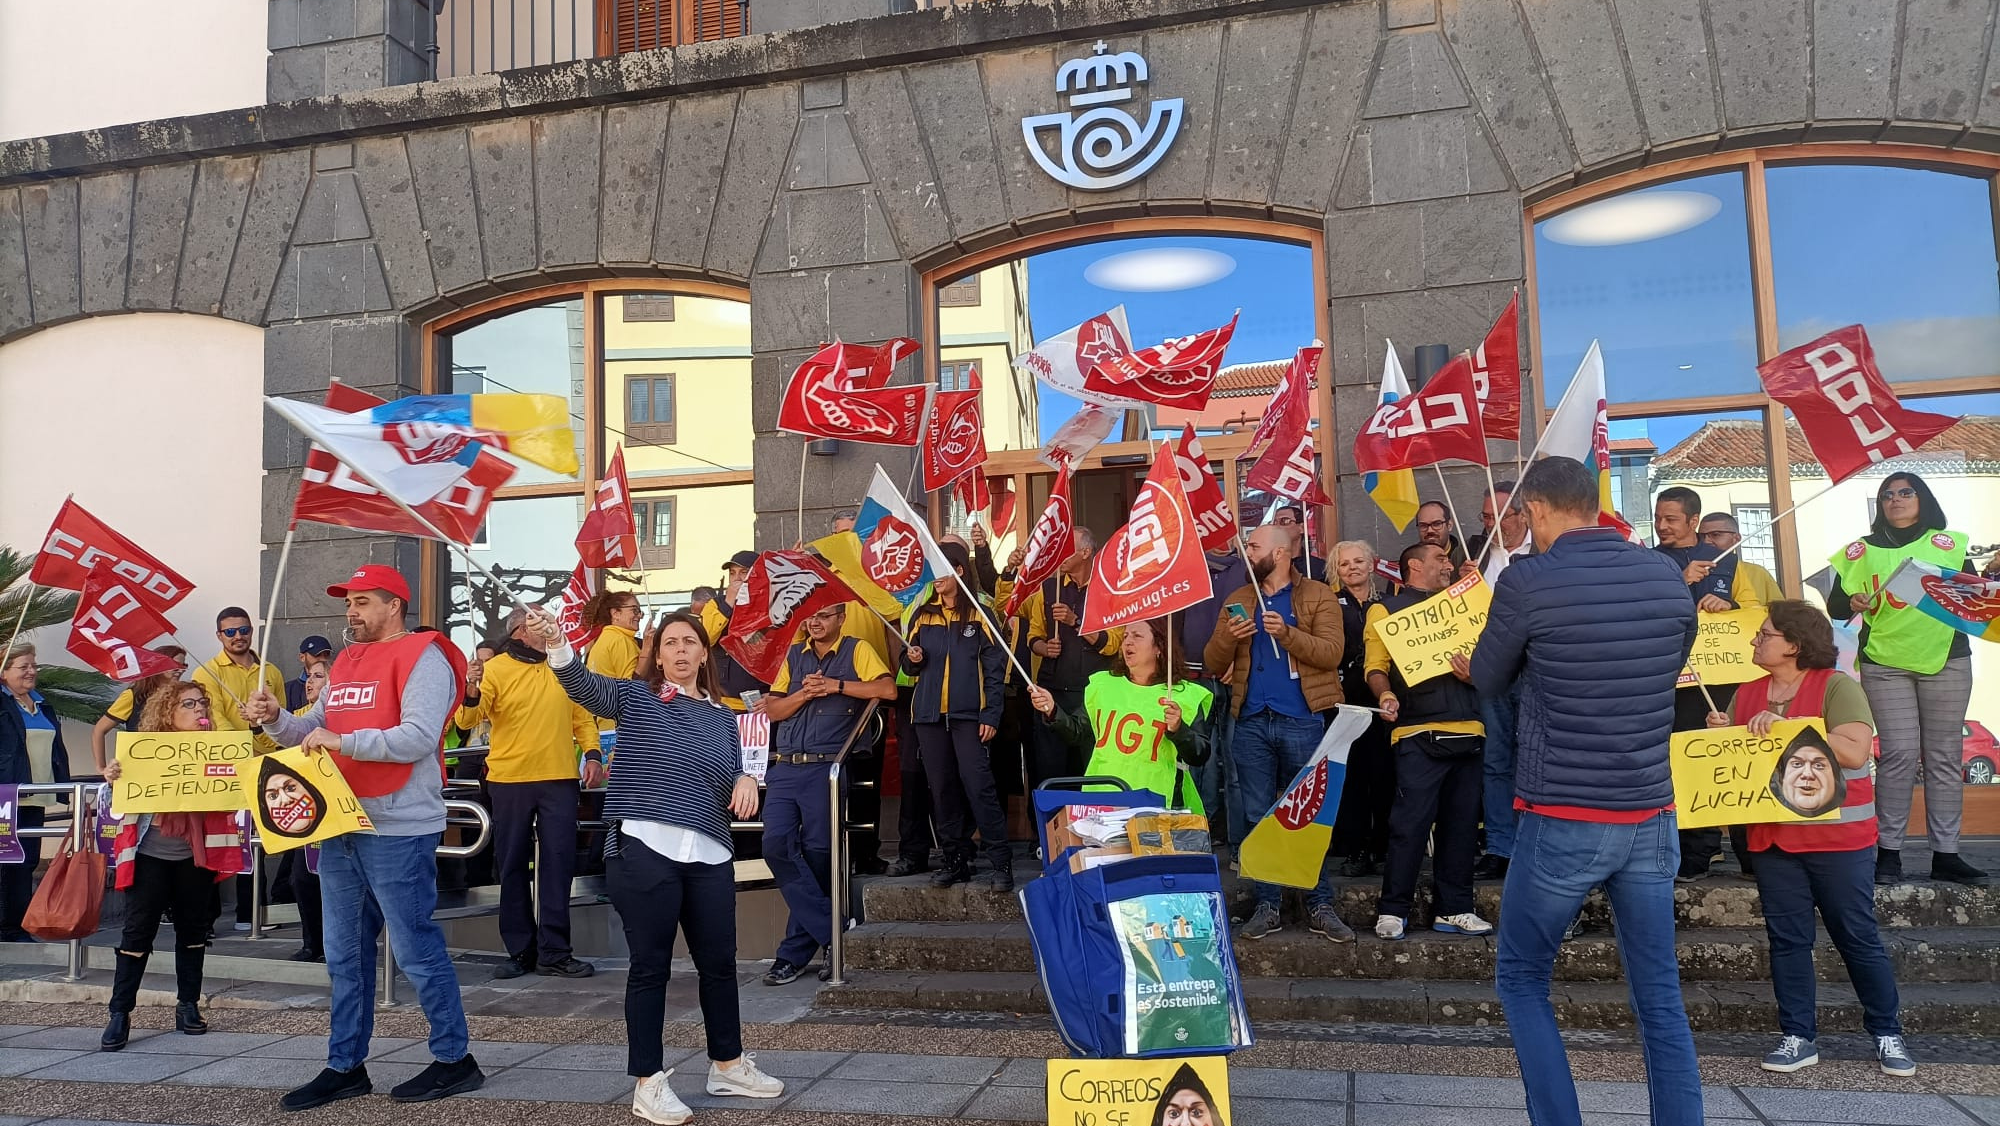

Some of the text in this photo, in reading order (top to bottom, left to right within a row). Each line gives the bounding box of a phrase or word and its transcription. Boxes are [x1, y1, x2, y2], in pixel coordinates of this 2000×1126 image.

[43, 528, 178, 600] CCOO
[1449, 574, 1479, 598] CCOO
[1102, 579, 1191, 626] www.ugt.es
[1406, 612, 1488, 648] UN SERVICIO
[1697, 621, 1740, 636] RREOS
[1704, 638, 1720, 648] SE
[1404, 660, 1423, 675] ES
[1688, 652, 1744, 666] EFIENDE
[327, 687, 374, 706] CCOO
[1096, 709, 1168, 762] UGT
[128, 738, 252, 761] CORREOS
[1684, 738, 1784, 758] CORREOS
[160, 763, 197, 777] SE
[207, 765, 236, 775] CCO
[1713, 761, 1752, 784] EN
[127, 779, 242, 800] DEFIENDE
[1690, 786, 1776, 813] LUCHA
[1137, 979, 1216, 994] Esta entrega
[1137, 992, 1221, 1010] es sostenible.
[1060, 1069, 1162, 1103] CORREOS
[1075, 1110, 1096, 1126] NO
